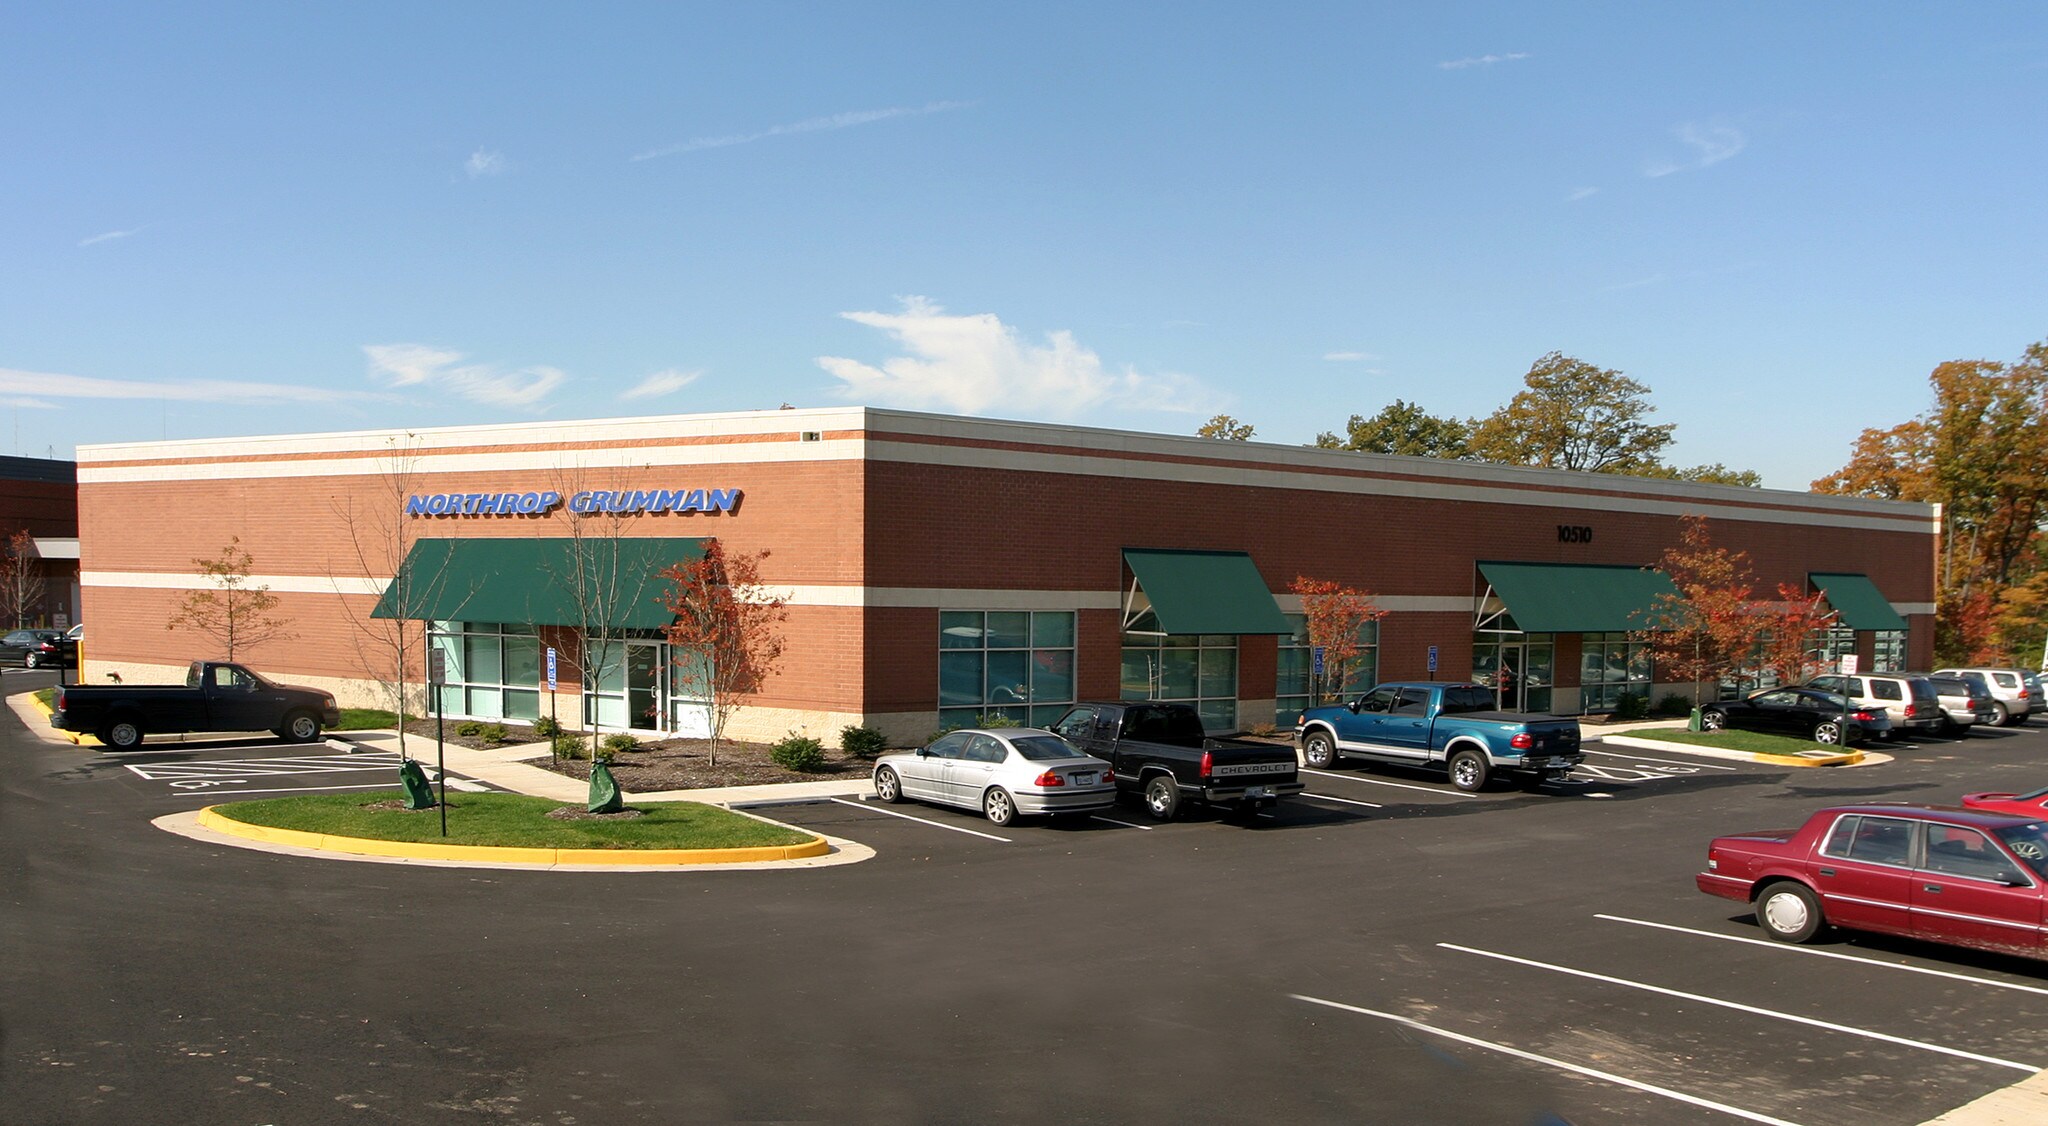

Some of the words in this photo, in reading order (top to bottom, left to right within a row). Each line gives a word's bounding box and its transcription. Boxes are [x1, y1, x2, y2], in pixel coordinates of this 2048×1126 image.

[405, 491, 560, 515] NORTHROP
[569, 488, 740, 514] GRUMMAN
[1557, 525, 1592, 543] 10510
[1221, 764, 1288, 775] CHEVROLET
